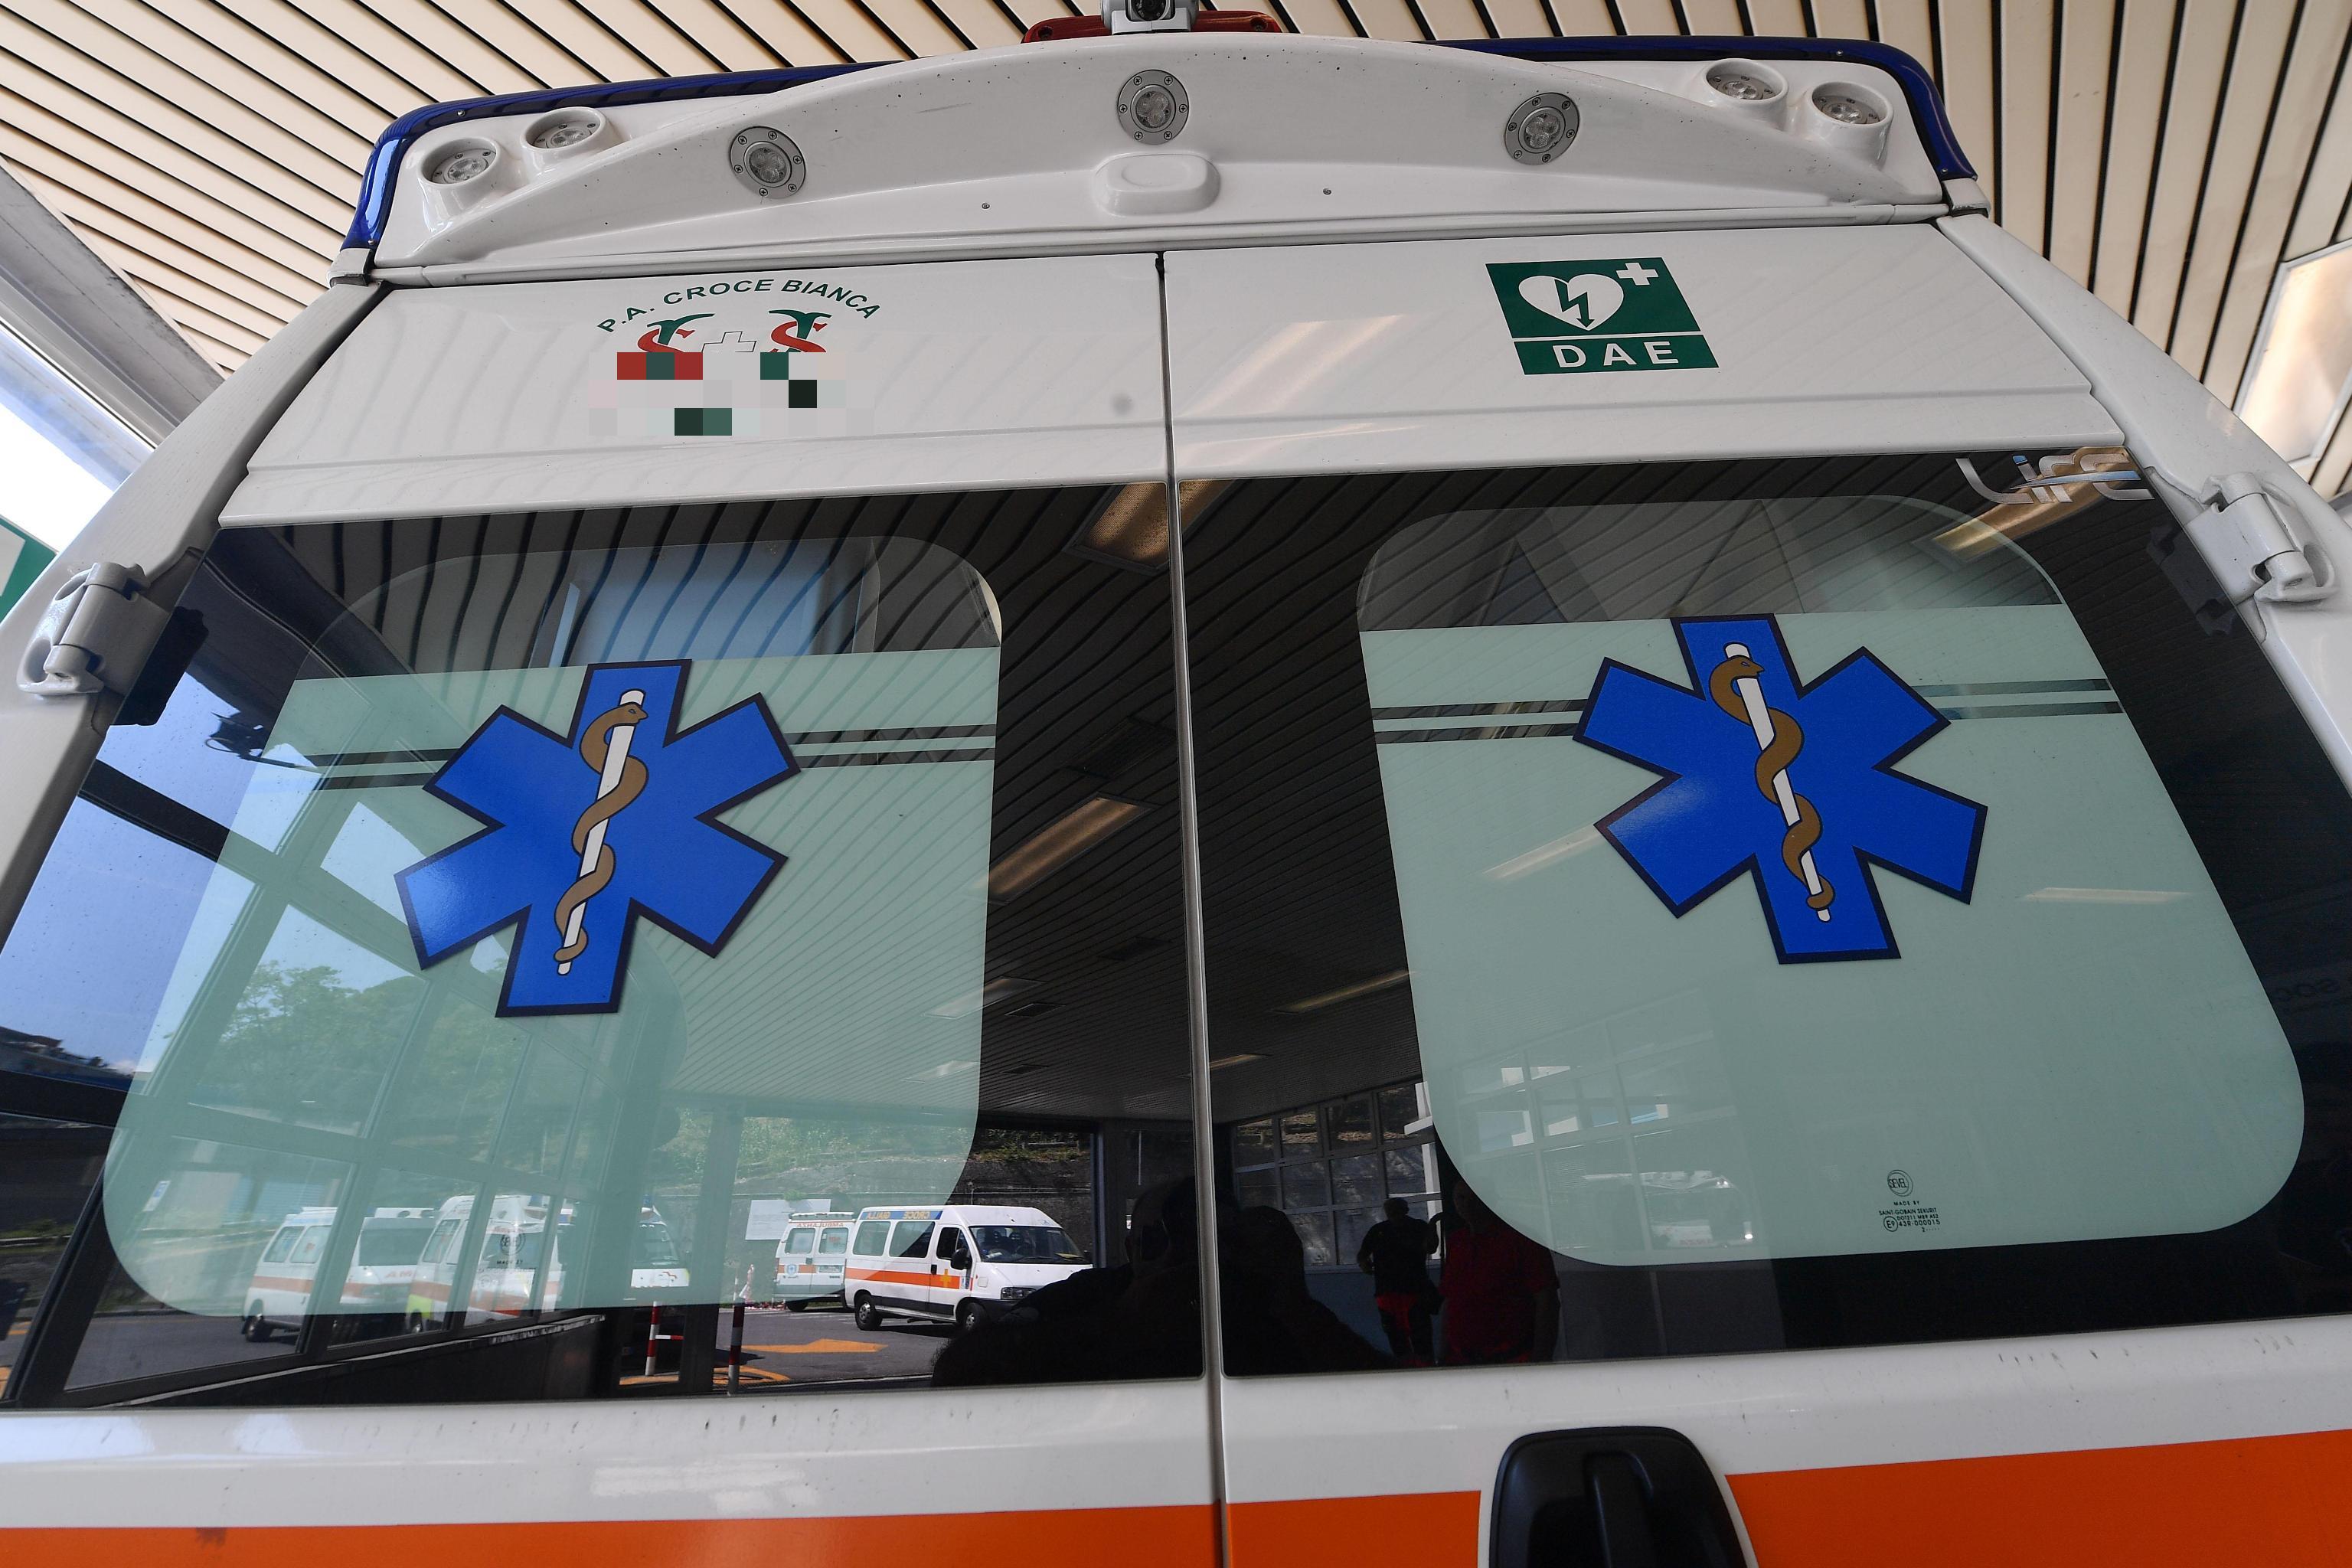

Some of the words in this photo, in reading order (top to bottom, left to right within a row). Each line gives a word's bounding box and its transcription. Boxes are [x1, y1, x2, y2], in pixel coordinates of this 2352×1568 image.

[597, 305, 655, 332] P.A.
[663, 279, 774, 305] CROCE
[781, 279, 880, 319] BIANCA
[1552, 341, 1679, 368] DAE
